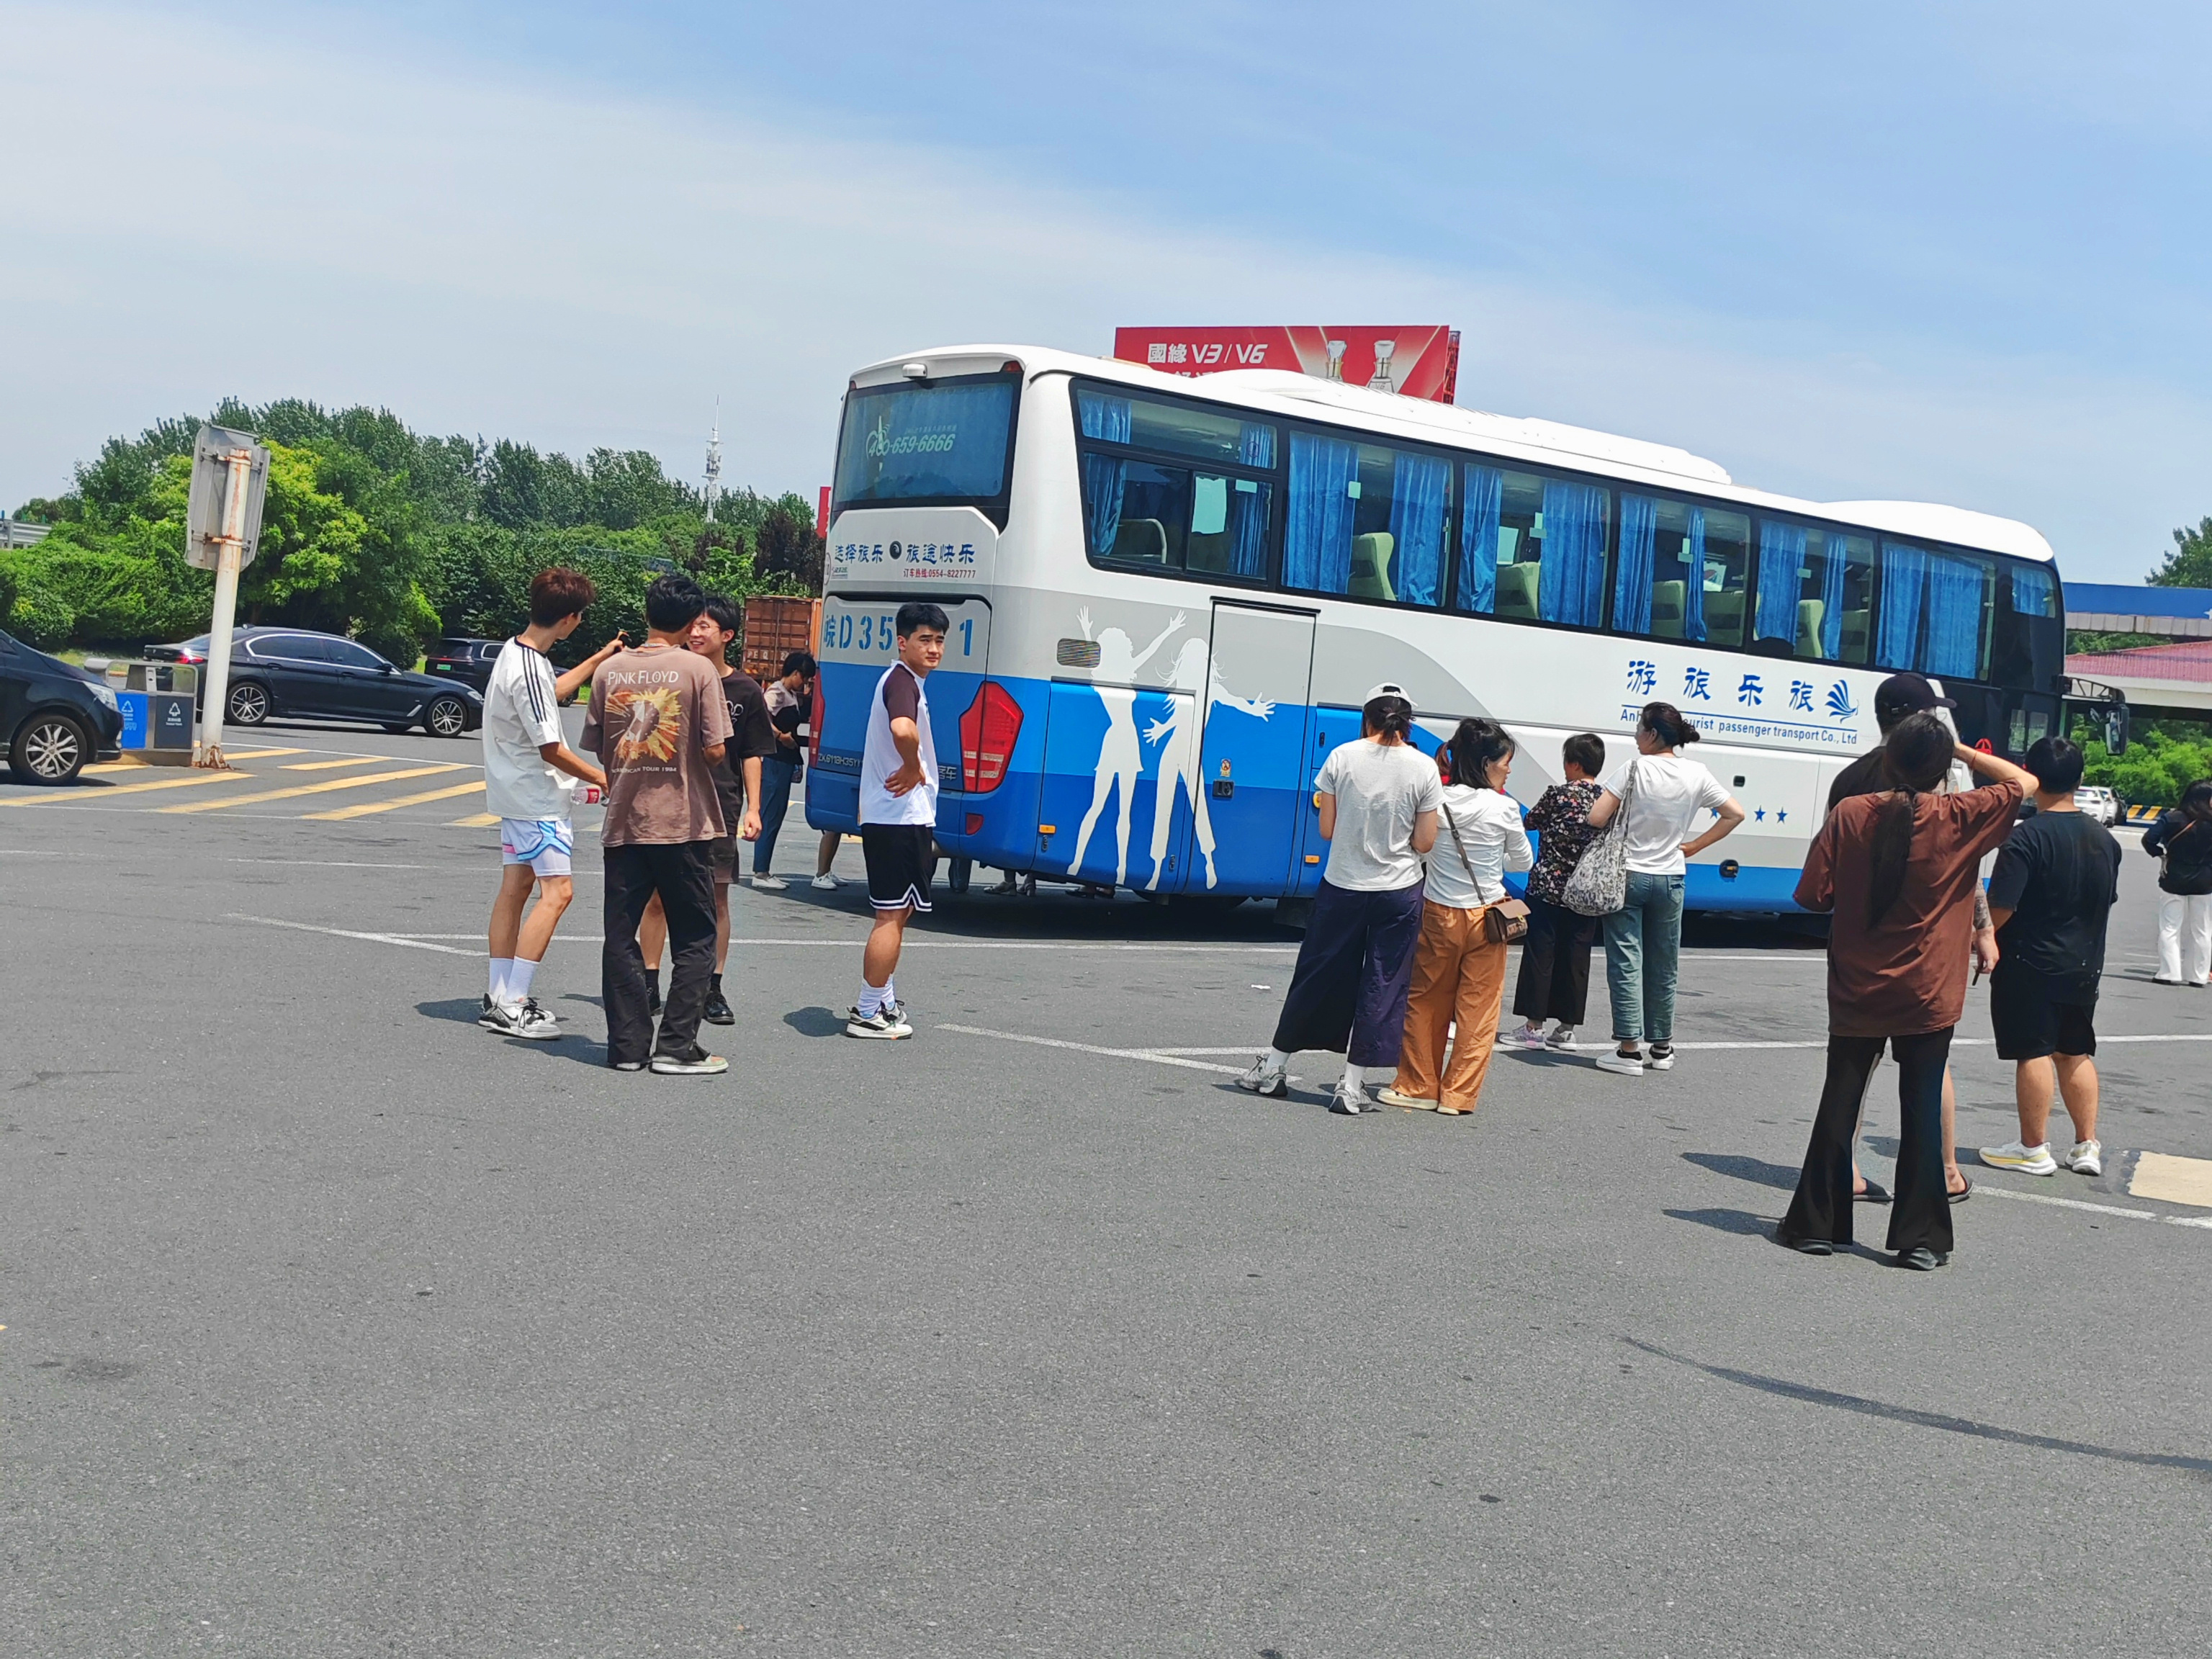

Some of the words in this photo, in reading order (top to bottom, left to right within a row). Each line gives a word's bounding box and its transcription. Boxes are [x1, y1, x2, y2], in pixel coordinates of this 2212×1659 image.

[1148, 343, 1187, 363] 國緣
[835, 544, 883, 564] 选择旅乐
[906, 543, 975, 565] 旅途快乐
[824, 614, 974, 656] 皖D351
[608, 671, 636, 685] PINK
[638, 670, 679, 684] FLOYD
[1620, 709, 1643, 723] Anh
[1689, 716, 1714, 730] urist
[1718, 721, 1771, 737] passenger
[1773, 726, 1820, 742] transport
[1841, 732, 1858, 745] Ltd
